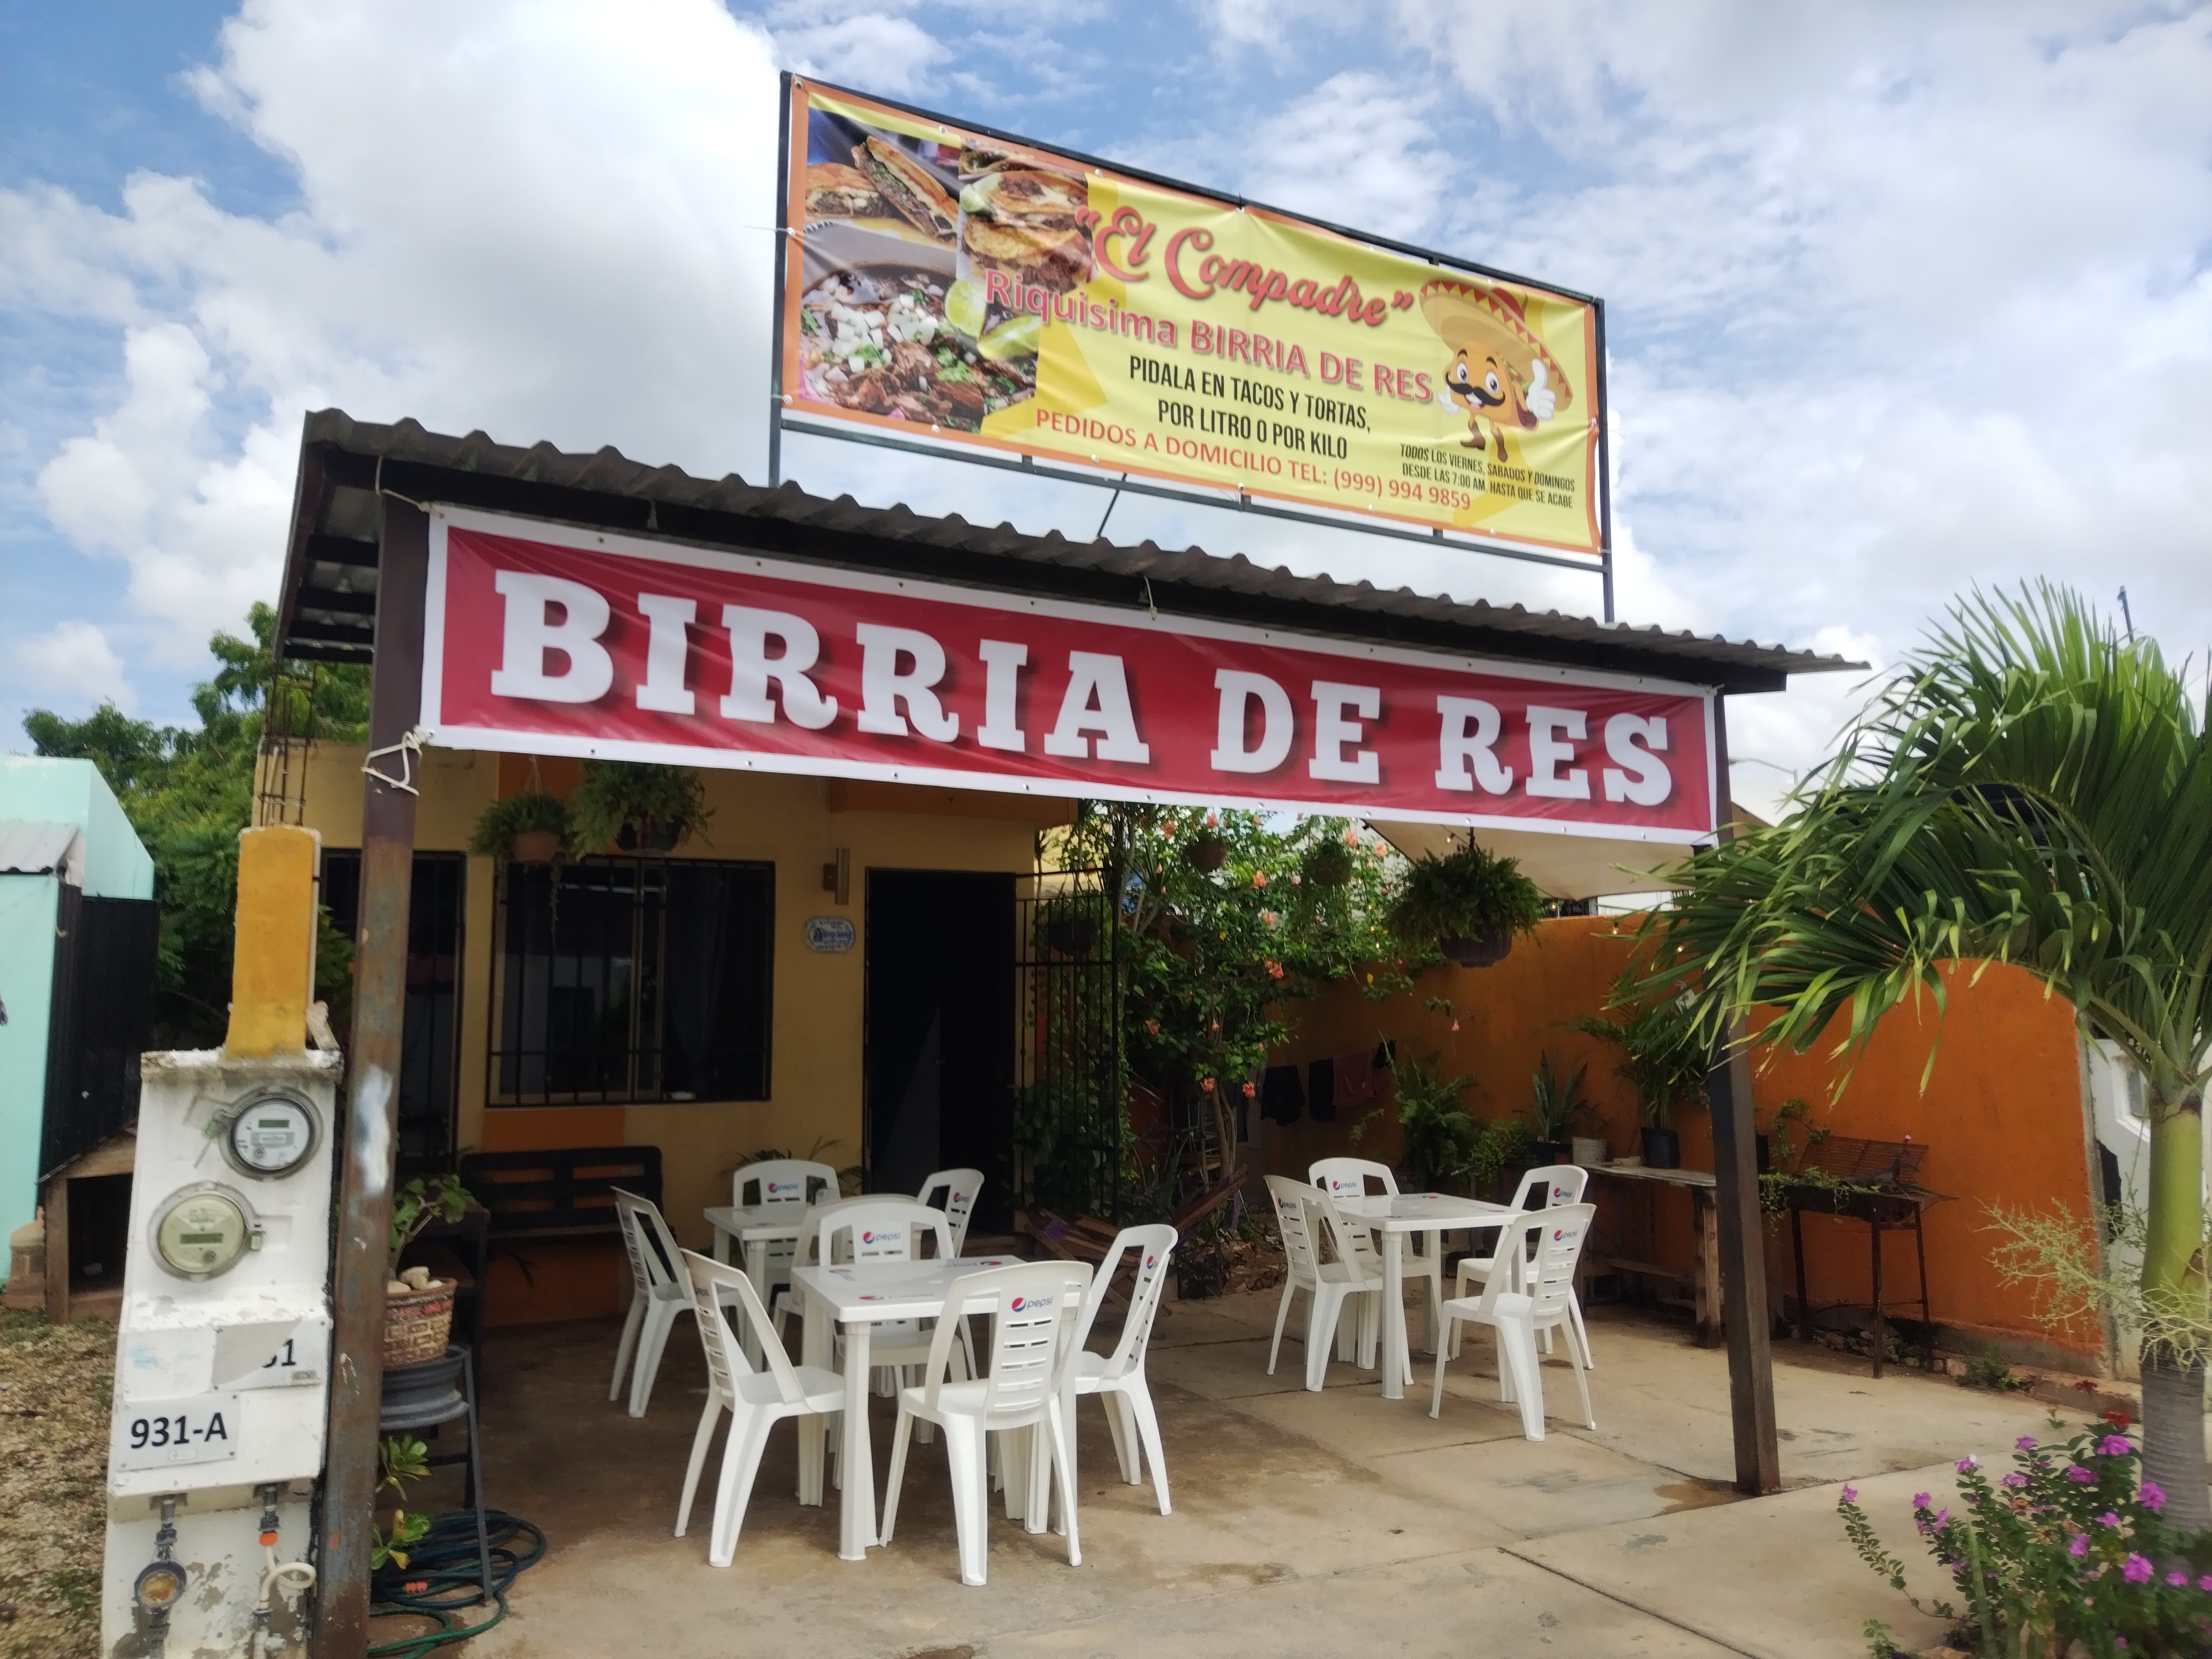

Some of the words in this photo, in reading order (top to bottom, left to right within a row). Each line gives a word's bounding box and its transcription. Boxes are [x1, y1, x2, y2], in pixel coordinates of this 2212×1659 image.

[986, 268, 1176, 346] Riquisima
[1191, 319, 1308, 377] BIRRIA
[1320, 350, 1363, 388] DE
[1373, 363, 1432, 403] RES
[1130, 355, 1195, 392] PIDALA
[1202, 371, 1224, 398] EN
[1230, 377, 1285, 410] TACOS
[1290, 390, 1300, 414] Y
[1304, 394, 1371, 434] TORTAS,
[1158, 398, 1194, 429] POR
[1200, 406, 1251, 439] LITRO
[1256, 419, 1267, 443] O
[1272, 421, 1306, 452] POR
[1311, 431, 1347, 459] KILO
[1036, 408, 1136, 447] PEDIDOS
[1142, 433, 1159, 452] A
[1166, 436, 1281, 474] DOMICILIO
[1287, 459, 1327, 485] TEL:
[1334, 467, 1383, 498] (999)
[1389, 478, 1423, 502] 994
[1428, 486, 1470, 510] 9859
[1400, 443, 1429, 462] TODOS
[1431, 448, 1447, 465] LOS
[1449, 452, 1485, 476] VIERNES,
[1487, 462, 1526, 483] SABADOS
[1528, 469, 1533, 484] Y
[1534, 471, 1575, 492] DOMINGOS
[1402, 462, 1432, 481] DESDE
[1434, 467, 1450, 484] LAS
[1452, 471, 1471, 489] 7:00
[1490, 479, 1516, 498] HASTA
[1517, 486, 1533, 502] QUE
[1535, 489, 1546, 504] SE
[1548, 492, 1573, 509] ACABE
[490, 568, 1150, 764] BIRRIA
[1211, 668, 1380, 784] DE
[1435, 695, 1672, 806] RES
[777, 1183, 799, 1192] pepsi
[1340, 1181, 1357, 1190] pepsi
[874, 1231, 901, 1241] pepsi
[1563, 1230, 1577, 1239] pepsi
[1026, 1295, 1053, 1310] pepsi
[131, 1412, 228, 1449] 931-A
